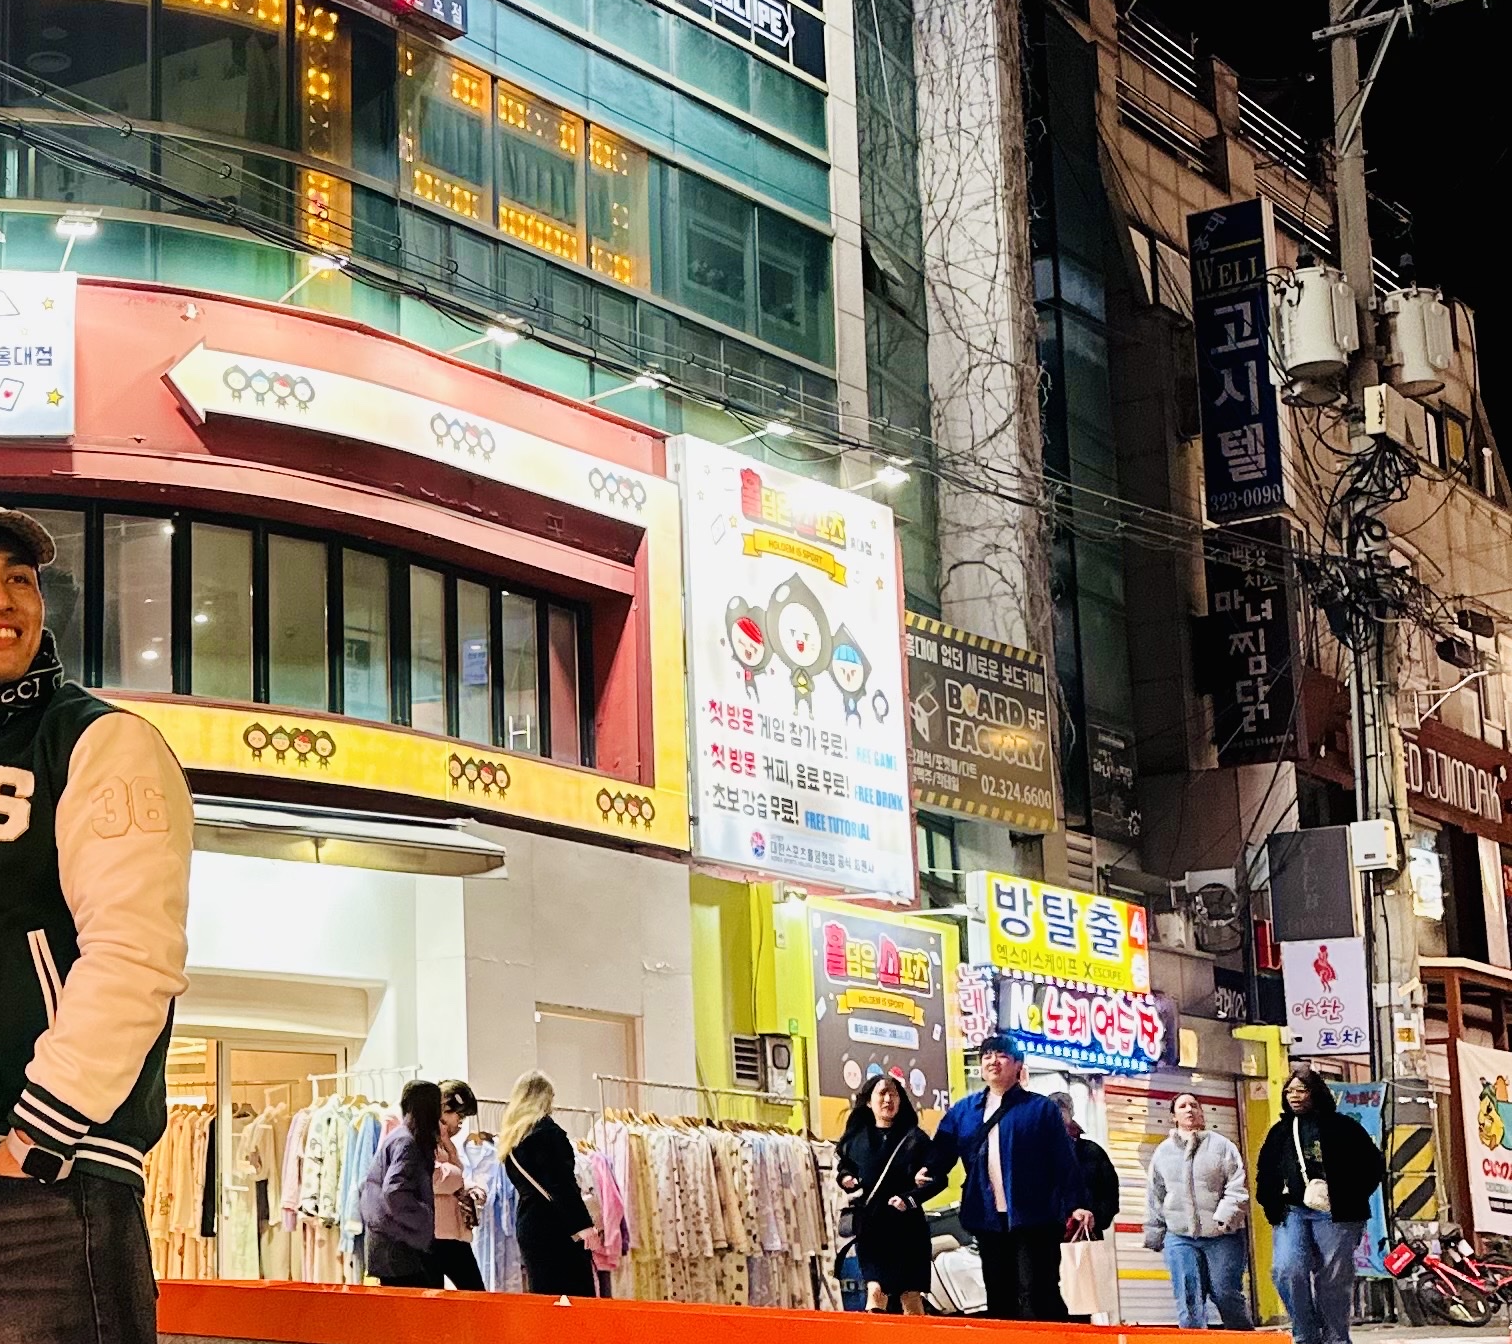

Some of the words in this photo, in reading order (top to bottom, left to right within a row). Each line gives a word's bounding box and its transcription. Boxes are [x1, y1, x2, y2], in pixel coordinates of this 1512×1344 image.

[1196, 256, 1263, 291] WELL
[1210, 302, 1267, 482] 고시텔
[769, 540, 795, 554] HOLDEM
[803, 550, 823, 564] SPORT
[967, 652, 999, 682] 새로운
[1028, 708, 1045, 730] 5F
[758, 714, 785, 743] 게임
[789, 722, 816, 750] 참가
[821, 730, 848, 759] 무료!
[763, 756, 793, 789] 커피,
[797, 764, 819, 792] 음료
[823, 770, 850, 799] 무료!
[981, 775, 1052, 808] 02.324.6600
[1427, 746, 1503, 824] JJIMDAK
[91, 775, 171, 839] 36
[876, 789, 904, 812] DRINK
[805, 811, 826, 833] FREE
[828, 814, 871, 841] TUTORIAL
[995, 882, 1121, 958] 방탈출
[997, 944, 1078, 976] 엑스이스케이프
[958, 965, 987, 1044] 노래방
[1293, 1001, 1342, 1023] 야한
[1044, 987, 1161, 1058] 노래연습장
[1320, 1031, 1363, 1047] 포차
